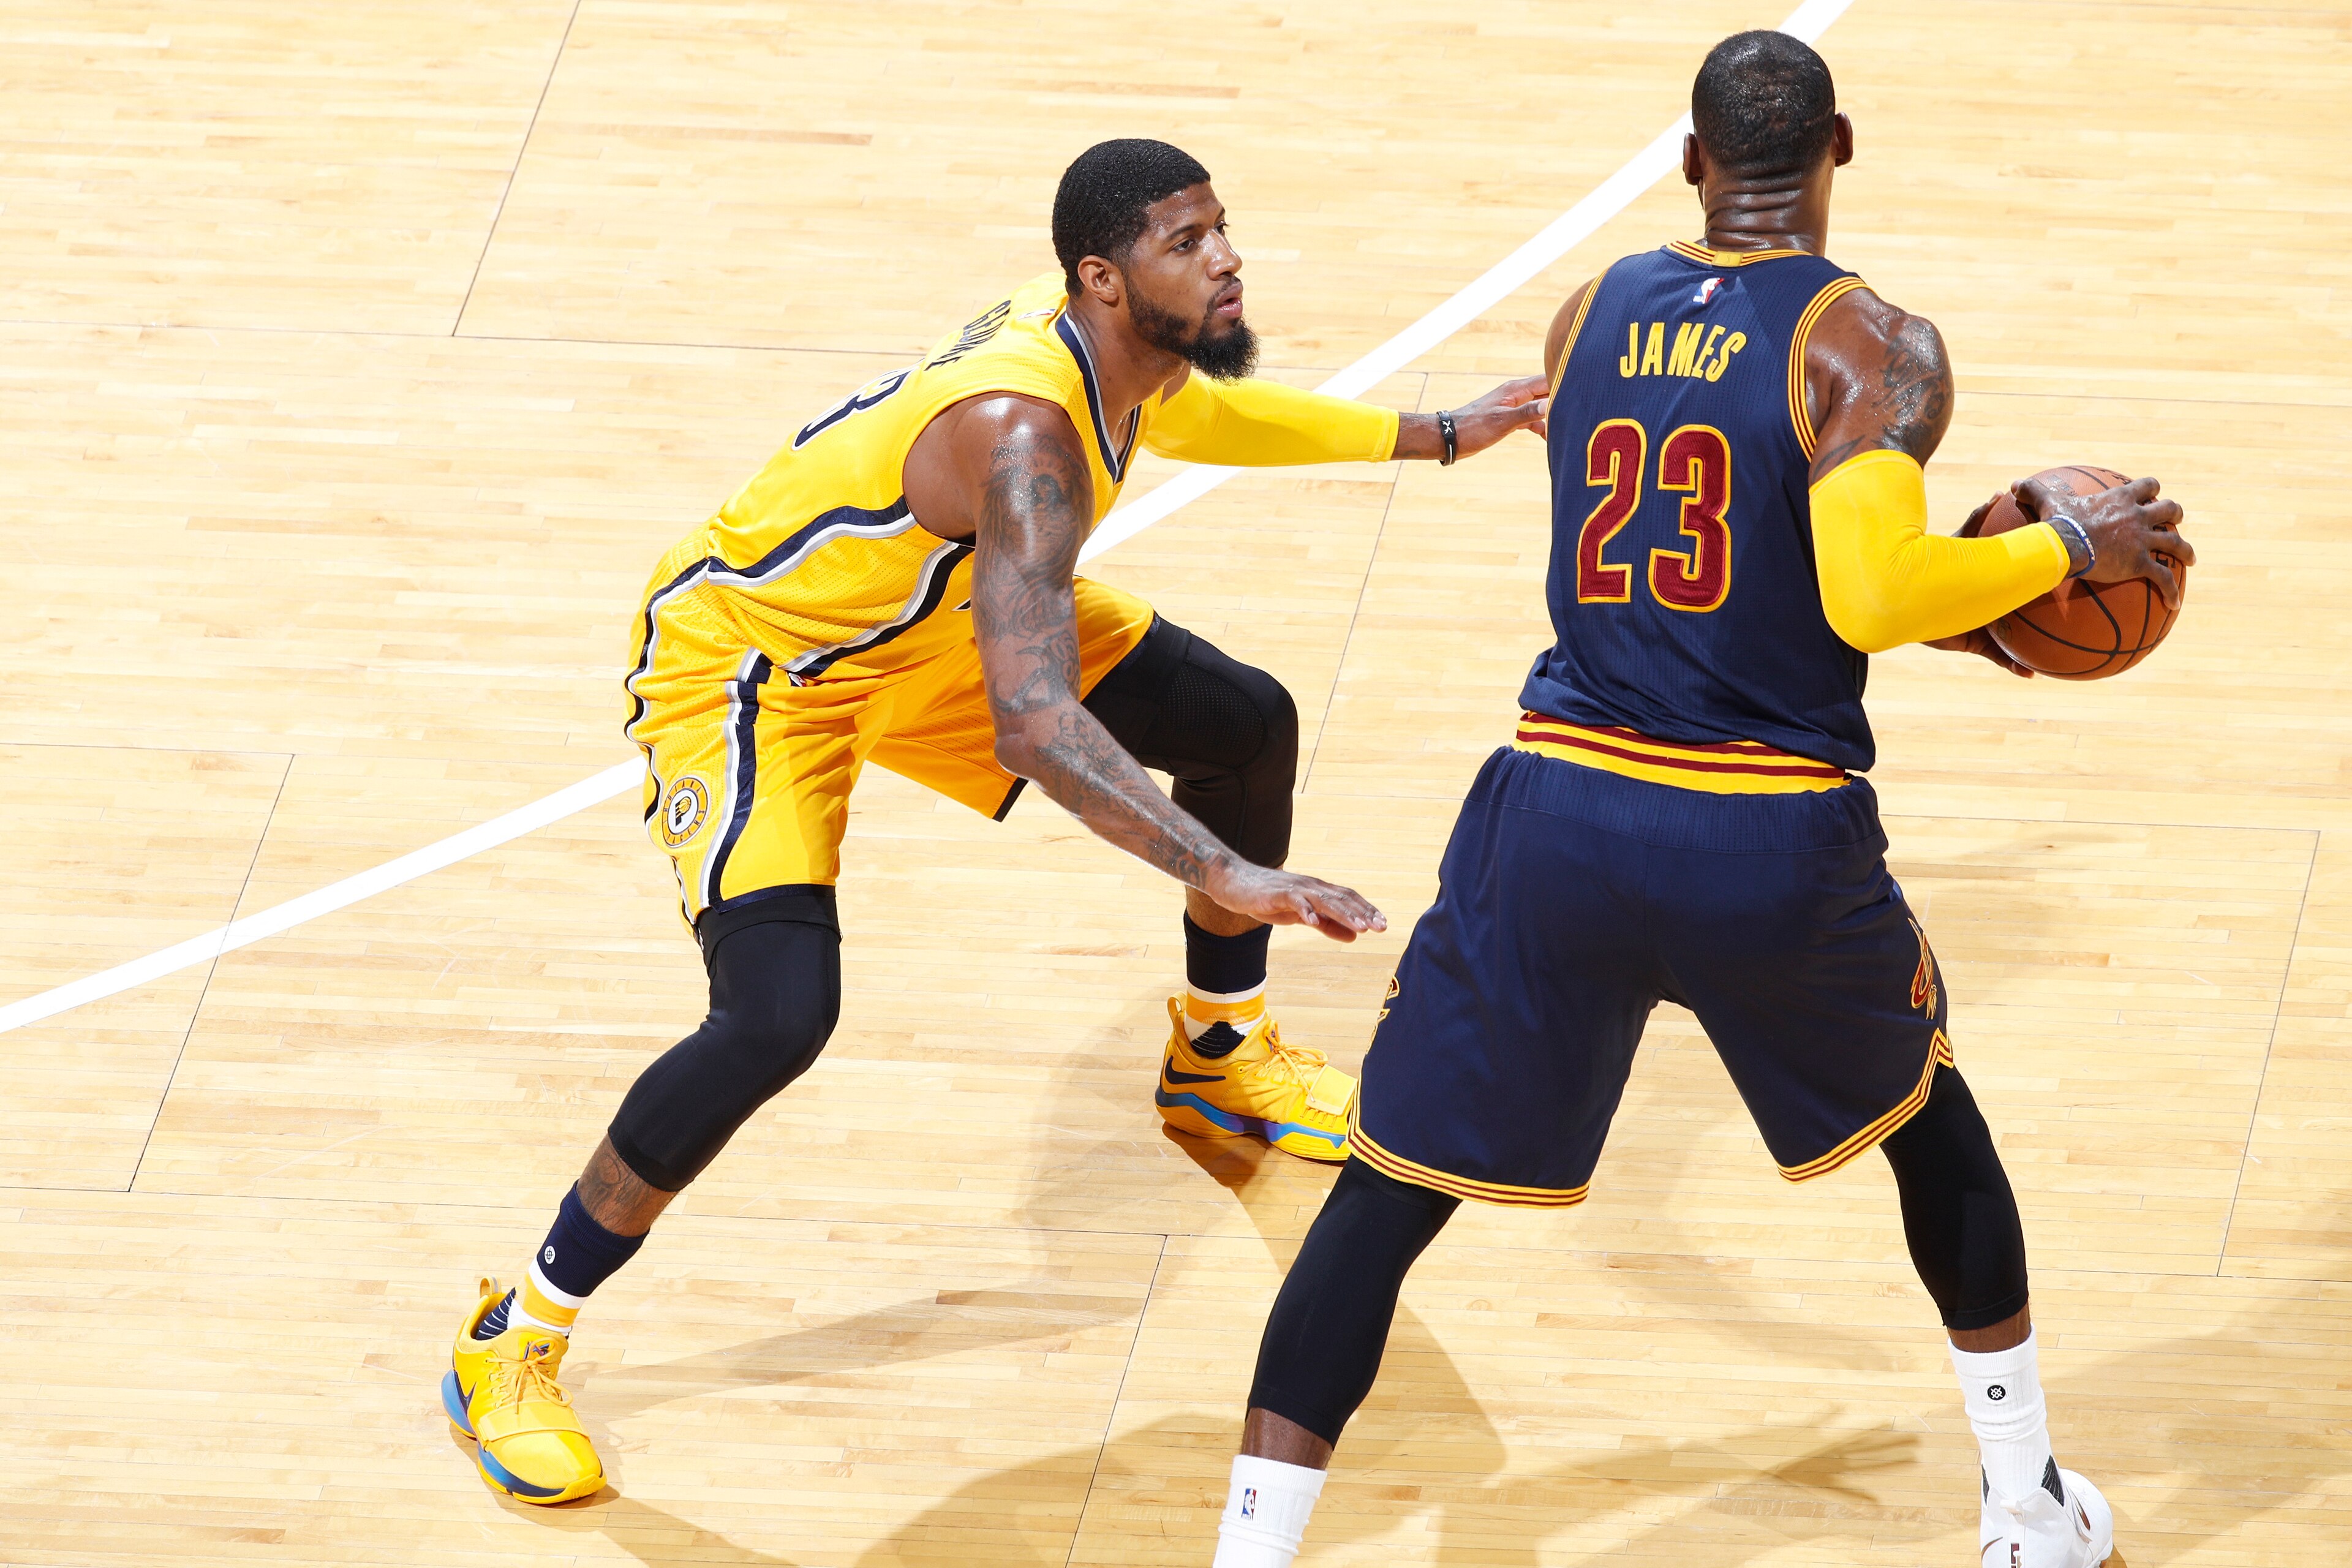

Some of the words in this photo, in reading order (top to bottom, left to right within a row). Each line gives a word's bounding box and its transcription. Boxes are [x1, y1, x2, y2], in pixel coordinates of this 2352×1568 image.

[924, 300, 1011, 371] GEORGE
[1619, 322, 1747, 382] JAMES
[792, 359, 924, 451] 3
[1578, 418, 1732, 612] 23
